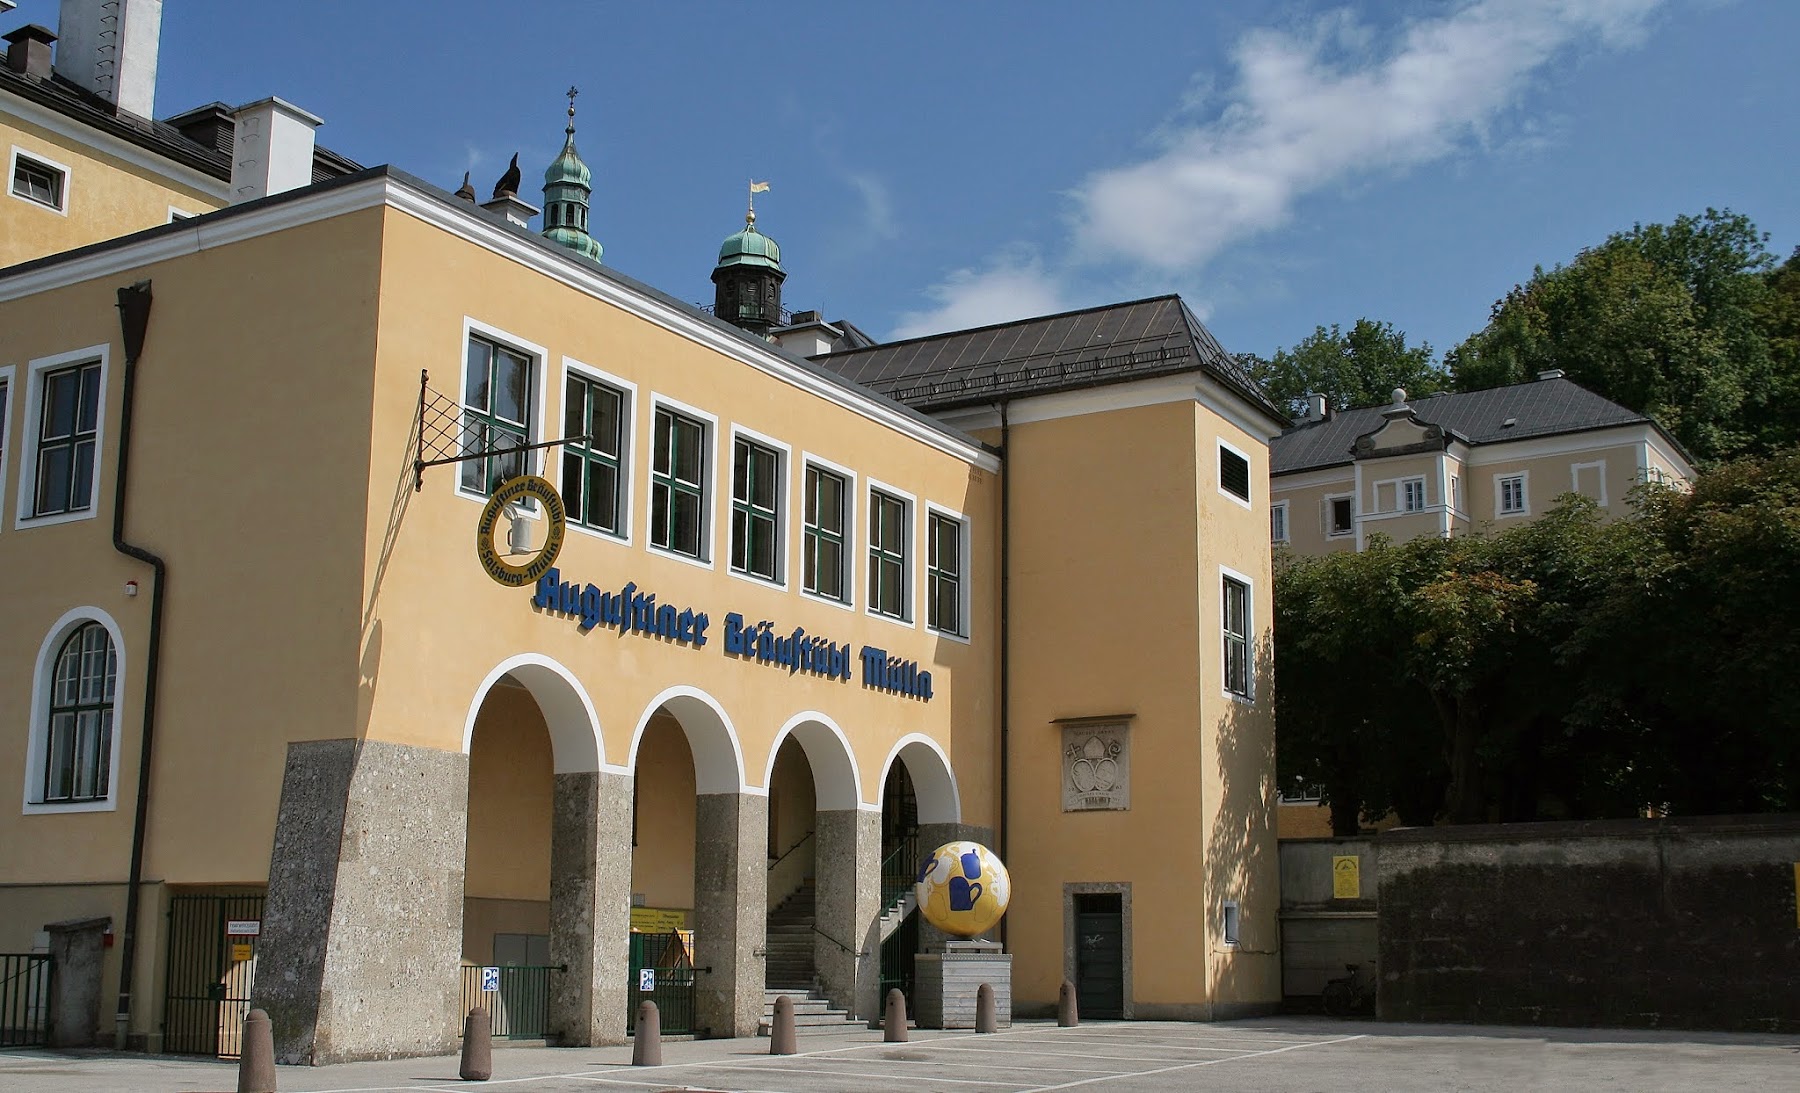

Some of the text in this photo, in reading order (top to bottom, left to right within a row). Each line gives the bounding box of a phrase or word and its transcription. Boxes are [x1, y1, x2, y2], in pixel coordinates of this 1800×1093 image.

[531, 567, 934, 701] Augustiner Bräustübl Mülln
